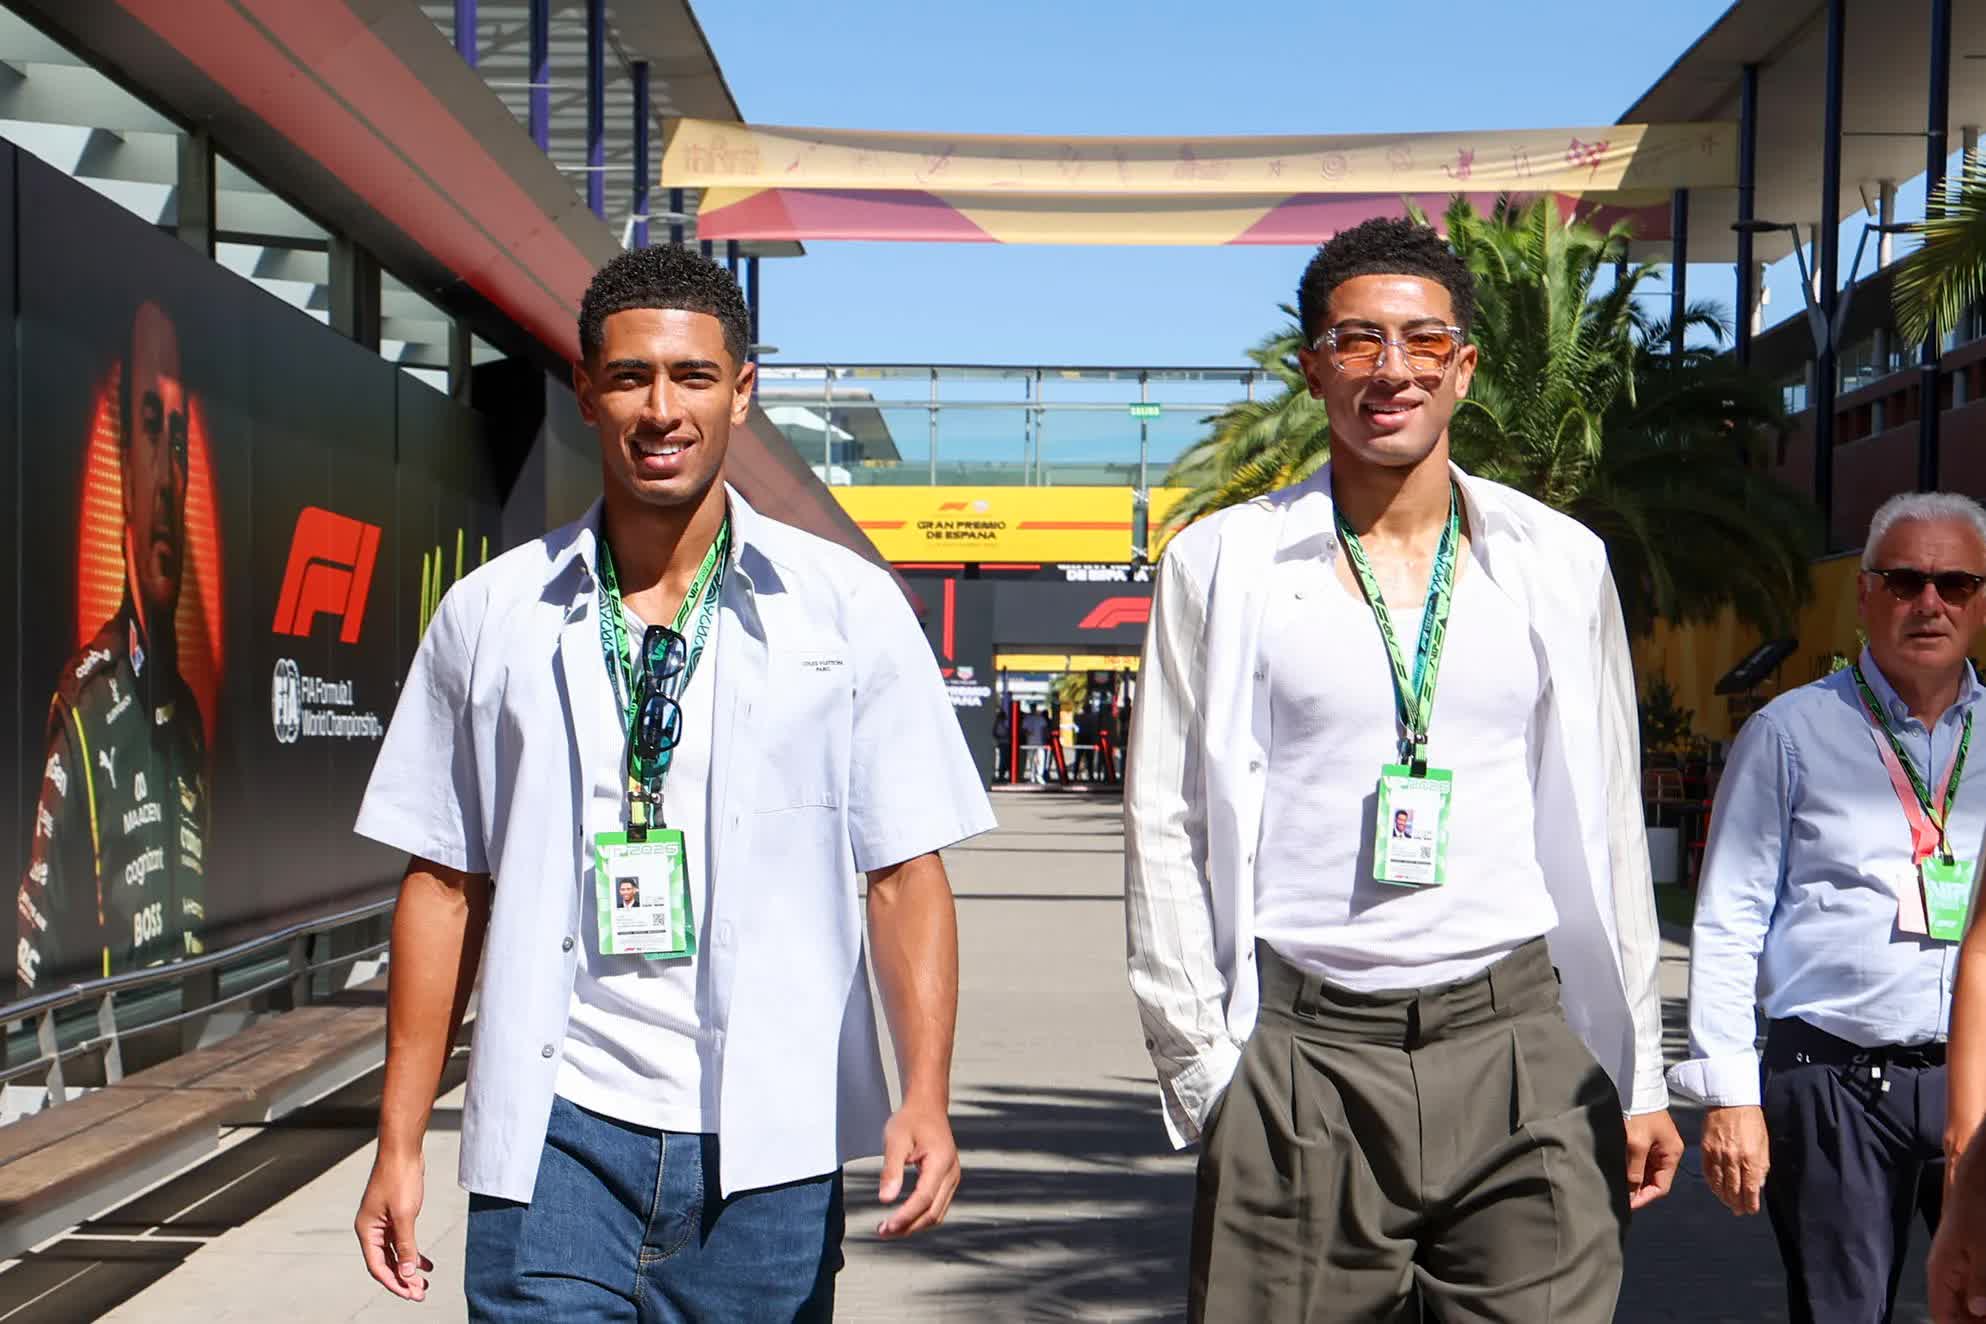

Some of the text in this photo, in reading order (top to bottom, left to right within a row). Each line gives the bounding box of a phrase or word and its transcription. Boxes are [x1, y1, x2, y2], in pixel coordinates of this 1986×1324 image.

[917, 521, 1006, 530] GRAN PREMIO
[926, 531, 942, 539] DE
[688, 582, 699, 599] VIP
[134, 902, 163, 947] BOSS
